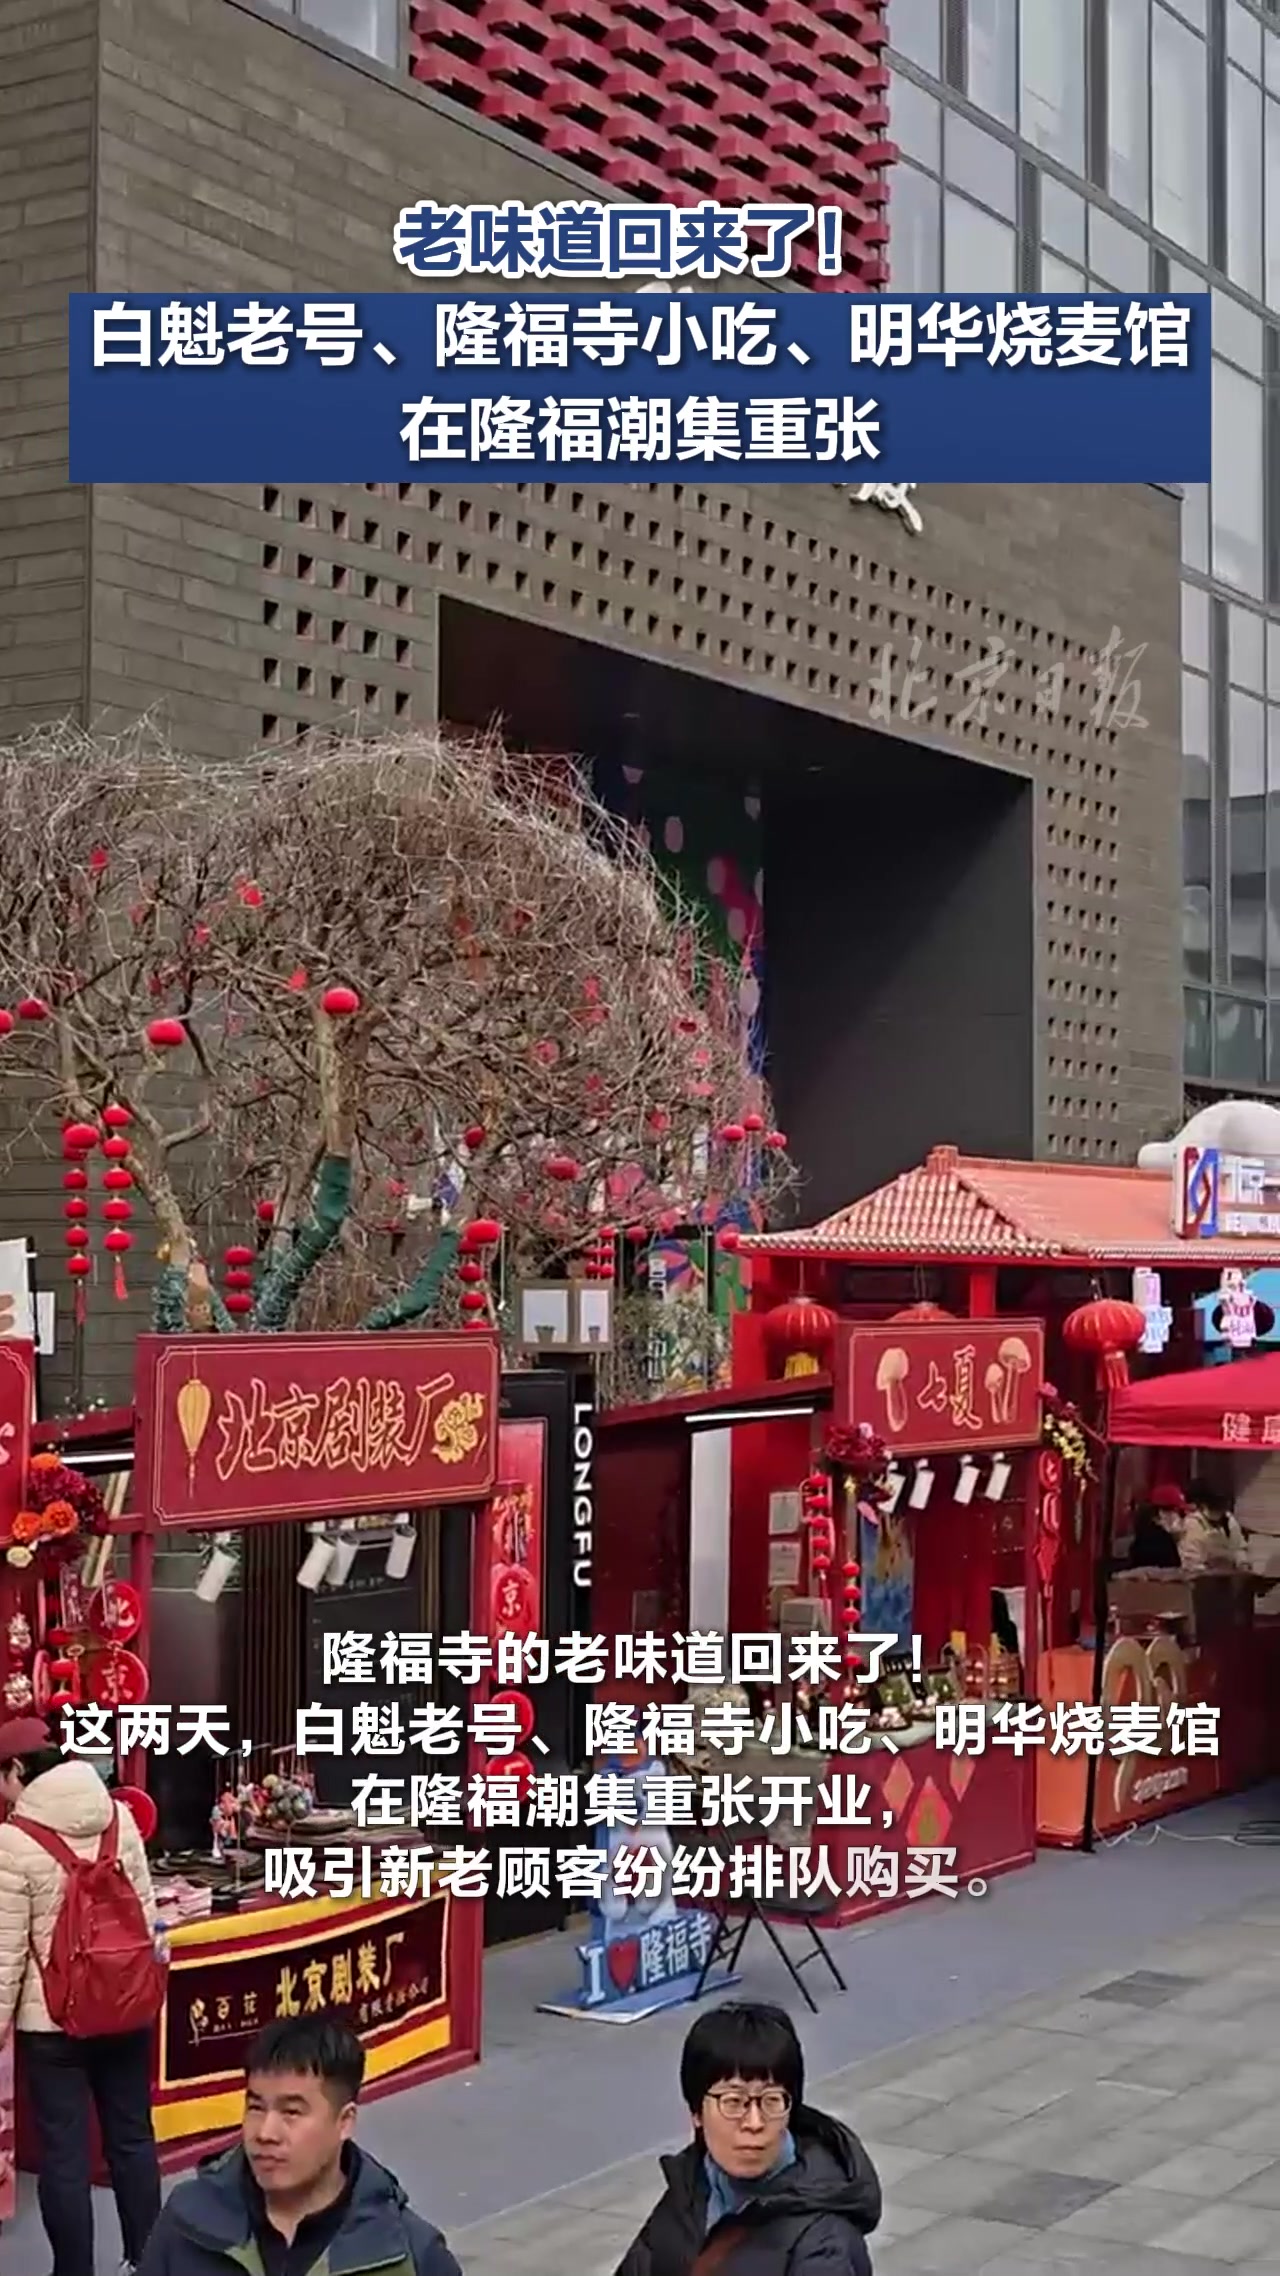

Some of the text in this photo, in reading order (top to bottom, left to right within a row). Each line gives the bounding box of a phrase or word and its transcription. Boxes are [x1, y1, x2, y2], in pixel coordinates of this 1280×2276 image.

[216, 1373, 455, 1480] 北京剧装厂
[572, 1404, 593, 1588] LONGFU
[276, 1932, 404, 2018] 北京剧装厂
[579, 1912, 712, 2005] I 隆福寺
